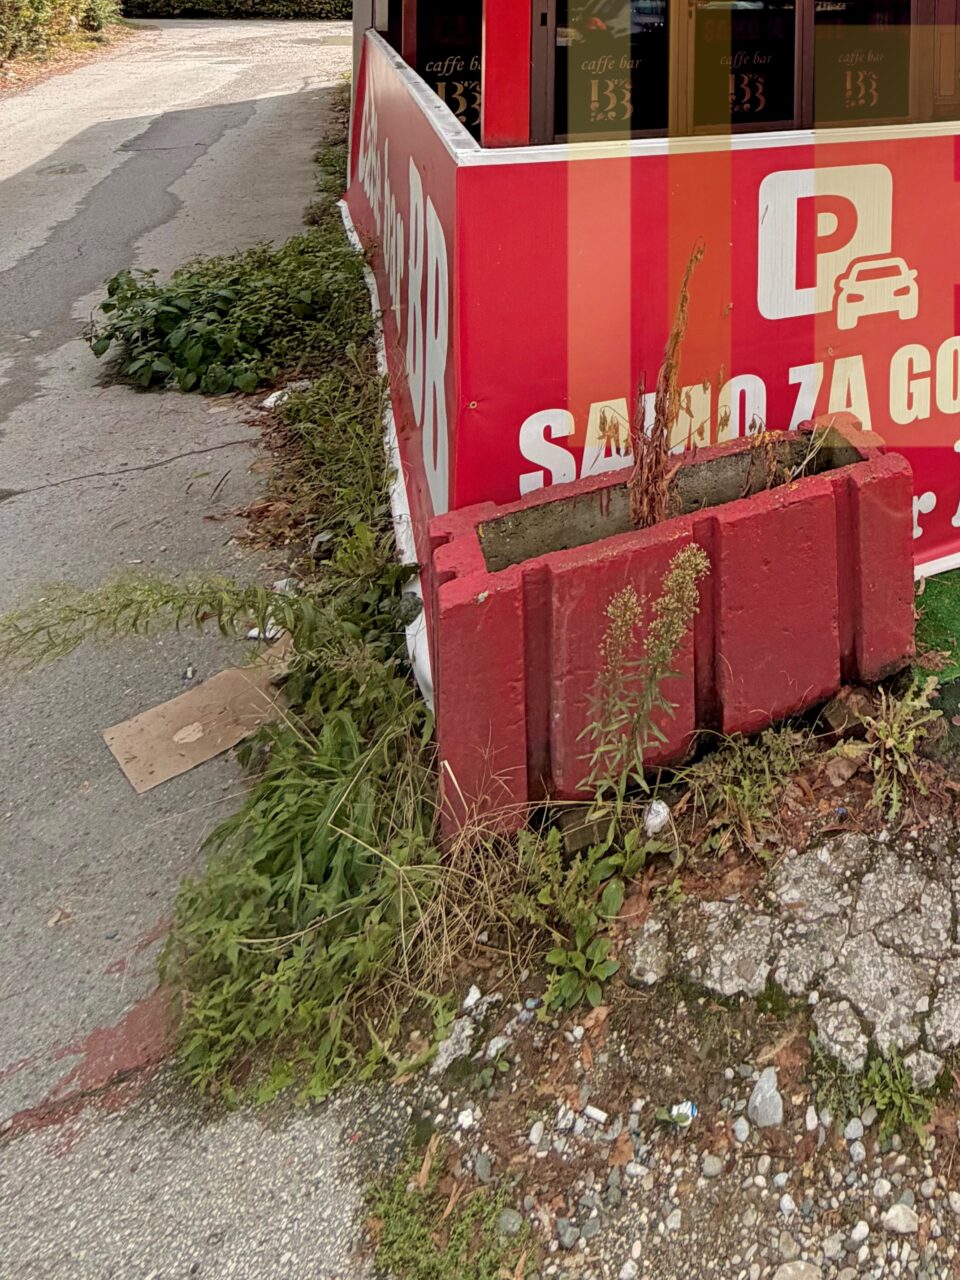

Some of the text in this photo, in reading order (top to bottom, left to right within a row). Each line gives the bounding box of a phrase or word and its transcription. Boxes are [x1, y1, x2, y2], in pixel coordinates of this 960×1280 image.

[425, 55, 465, 76] caffe
[581, 55, 643, 73] caffe bar
[788, 354, 873, 432] ZA
